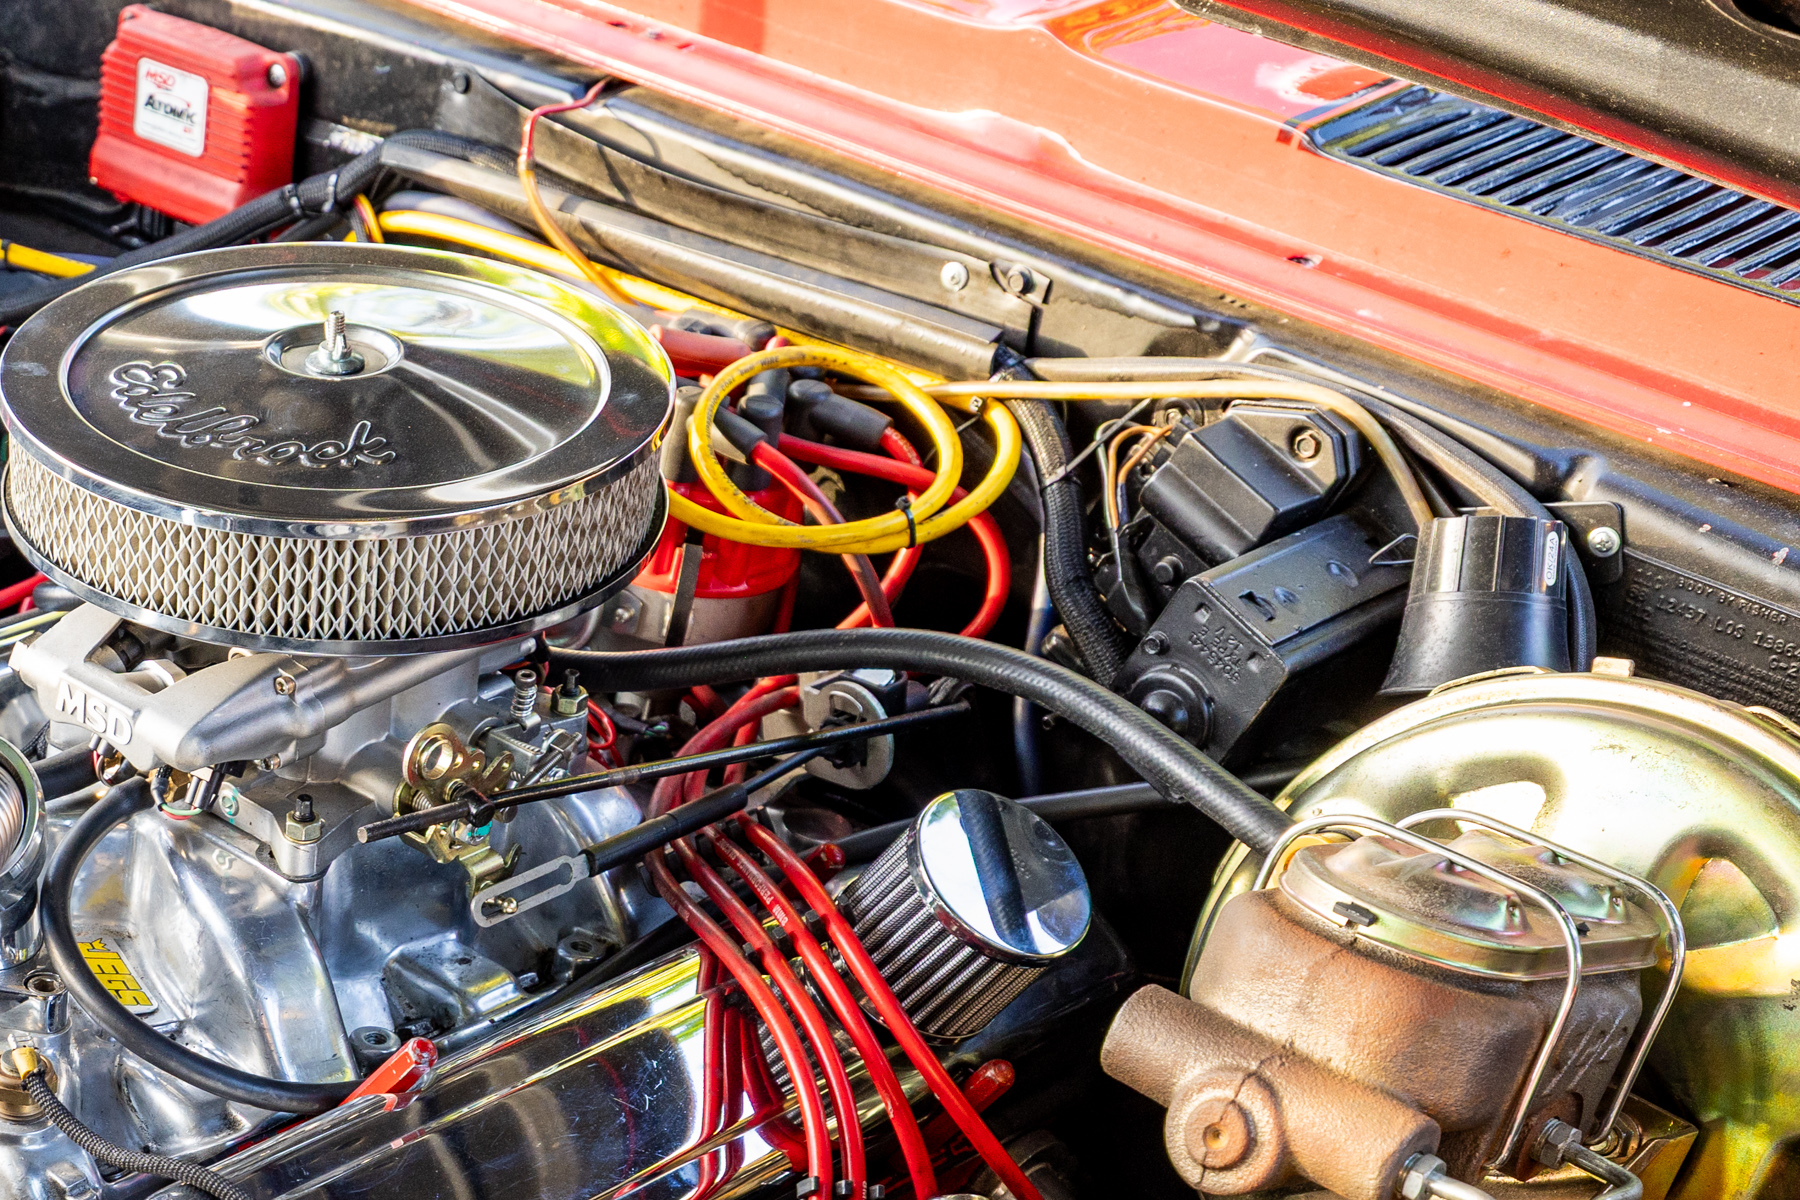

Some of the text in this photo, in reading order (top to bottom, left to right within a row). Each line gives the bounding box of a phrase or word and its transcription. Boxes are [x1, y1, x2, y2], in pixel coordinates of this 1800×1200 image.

[108, 360, 397, 470] Edelbrock
[56, 680, 133, 746] MSD
[77, 938, 154, 1007] JEGS
